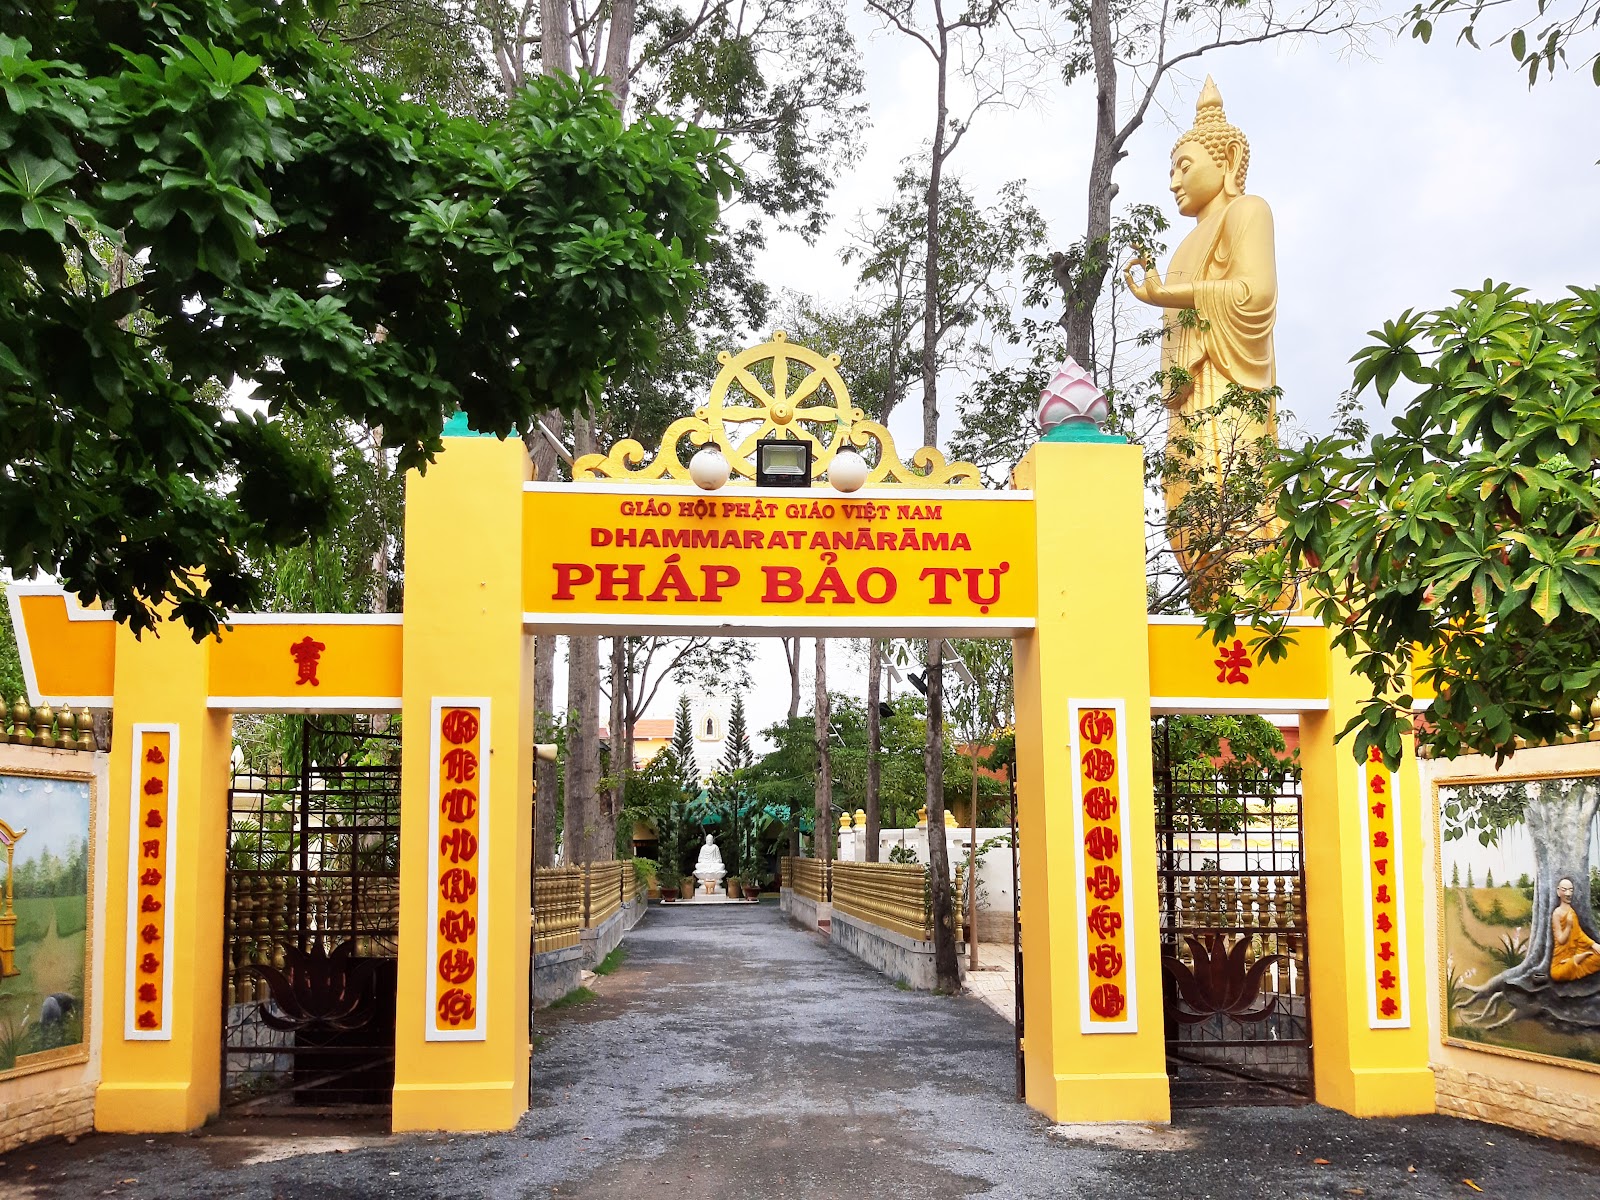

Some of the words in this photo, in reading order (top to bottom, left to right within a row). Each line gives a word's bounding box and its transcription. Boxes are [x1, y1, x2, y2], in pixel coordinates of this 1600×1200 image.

[621, 498, 671, 516] GIÁO
[679, 499, 717, 520] HỘI
[722, 500, 778, 520] PHẬT
[786, 501, 835, 519] GIÁO
[841, 501, 890, 522] VIỆT
[897, 506, 942, 519] NAM
[591, 528, 971, 553] DHAMMARATANĀRĀMA
[552, 553, 740, 602] PHÁP
[761, 552, 897, 604] BẢO
[919, 562, 1009, 614] TỰ
[1214, 640, 1254, 684] 法
